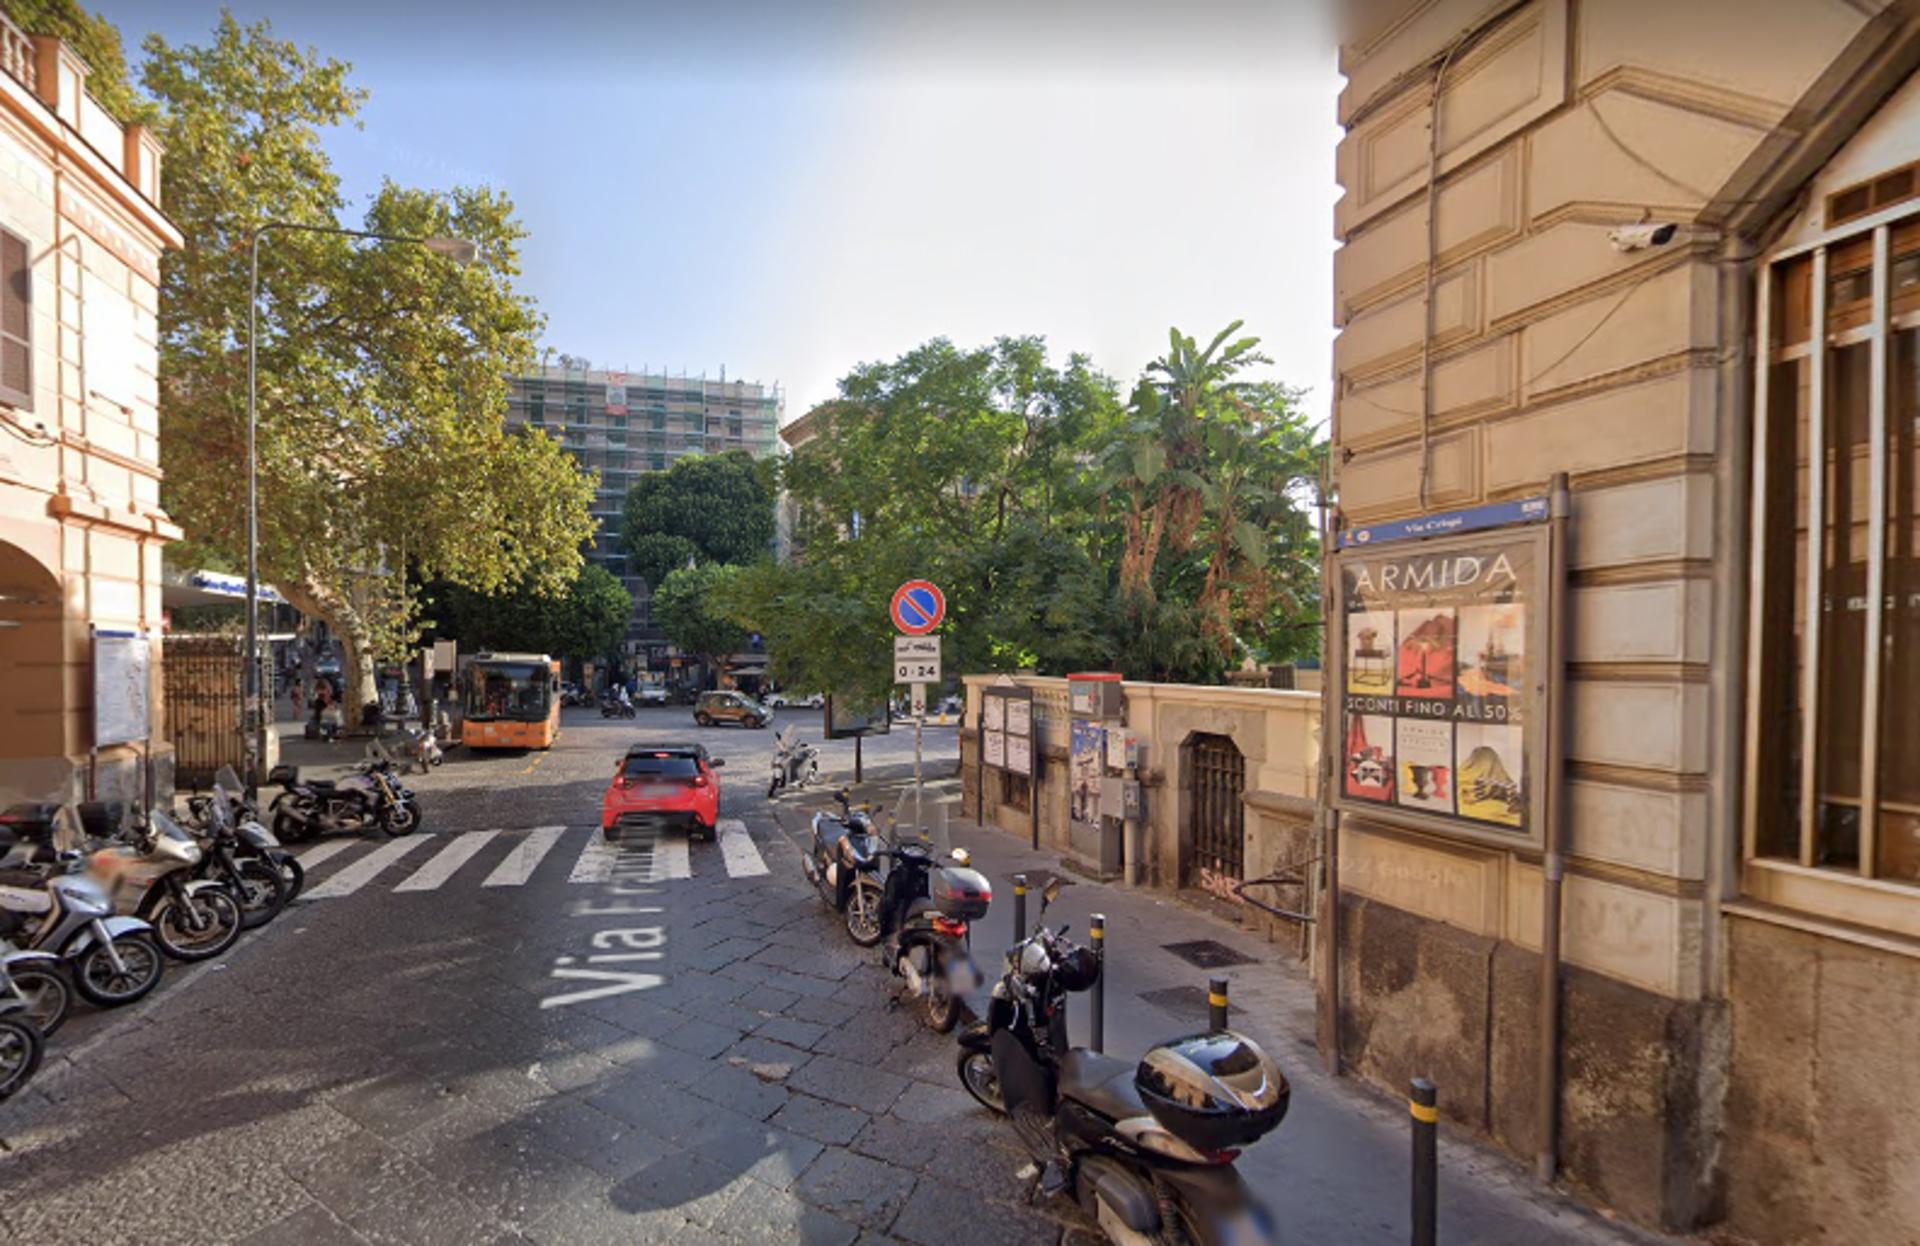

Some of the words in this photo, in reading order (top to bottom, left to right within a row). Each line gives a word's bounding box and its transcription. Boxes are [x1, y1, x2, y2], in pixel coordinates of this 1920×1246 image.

[1353, 553, 1517, 595] ARMIDA
[898, 666, 908, 677] 0
[917, 666, 936, 677] 24
[1348, 698, 1400, 713] SCONTI
[1405, 700, 1446, 716] FINO
